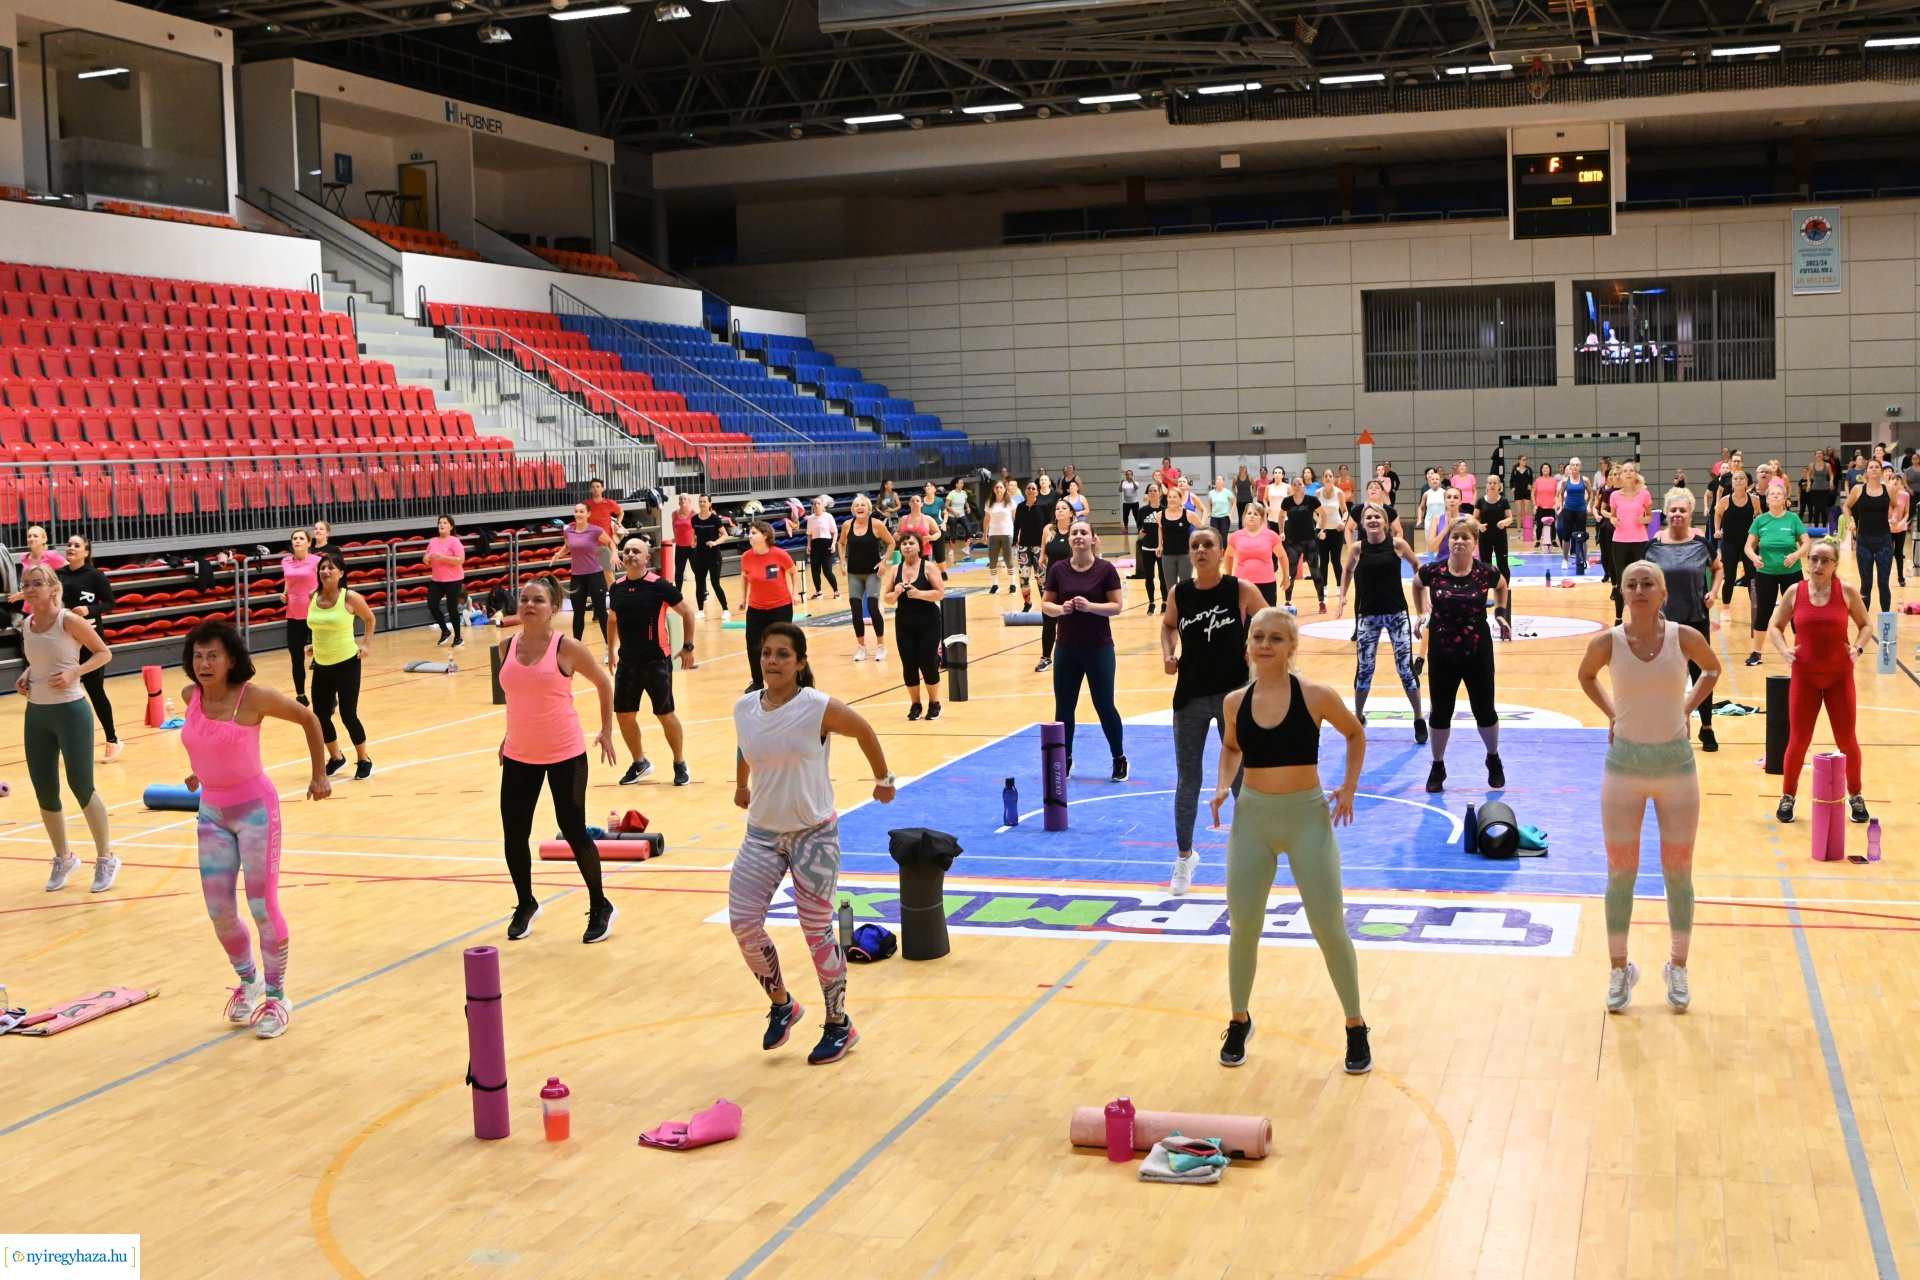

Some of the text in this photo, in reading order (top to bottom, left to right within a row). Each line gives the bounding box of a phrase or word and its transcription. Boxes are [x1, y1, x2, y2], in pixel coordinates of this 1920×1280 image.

[1178, 604, 1229, 635] move
[1203, 613, 1236, 643] free
[1054, 770, 1062, 795] TREXO
